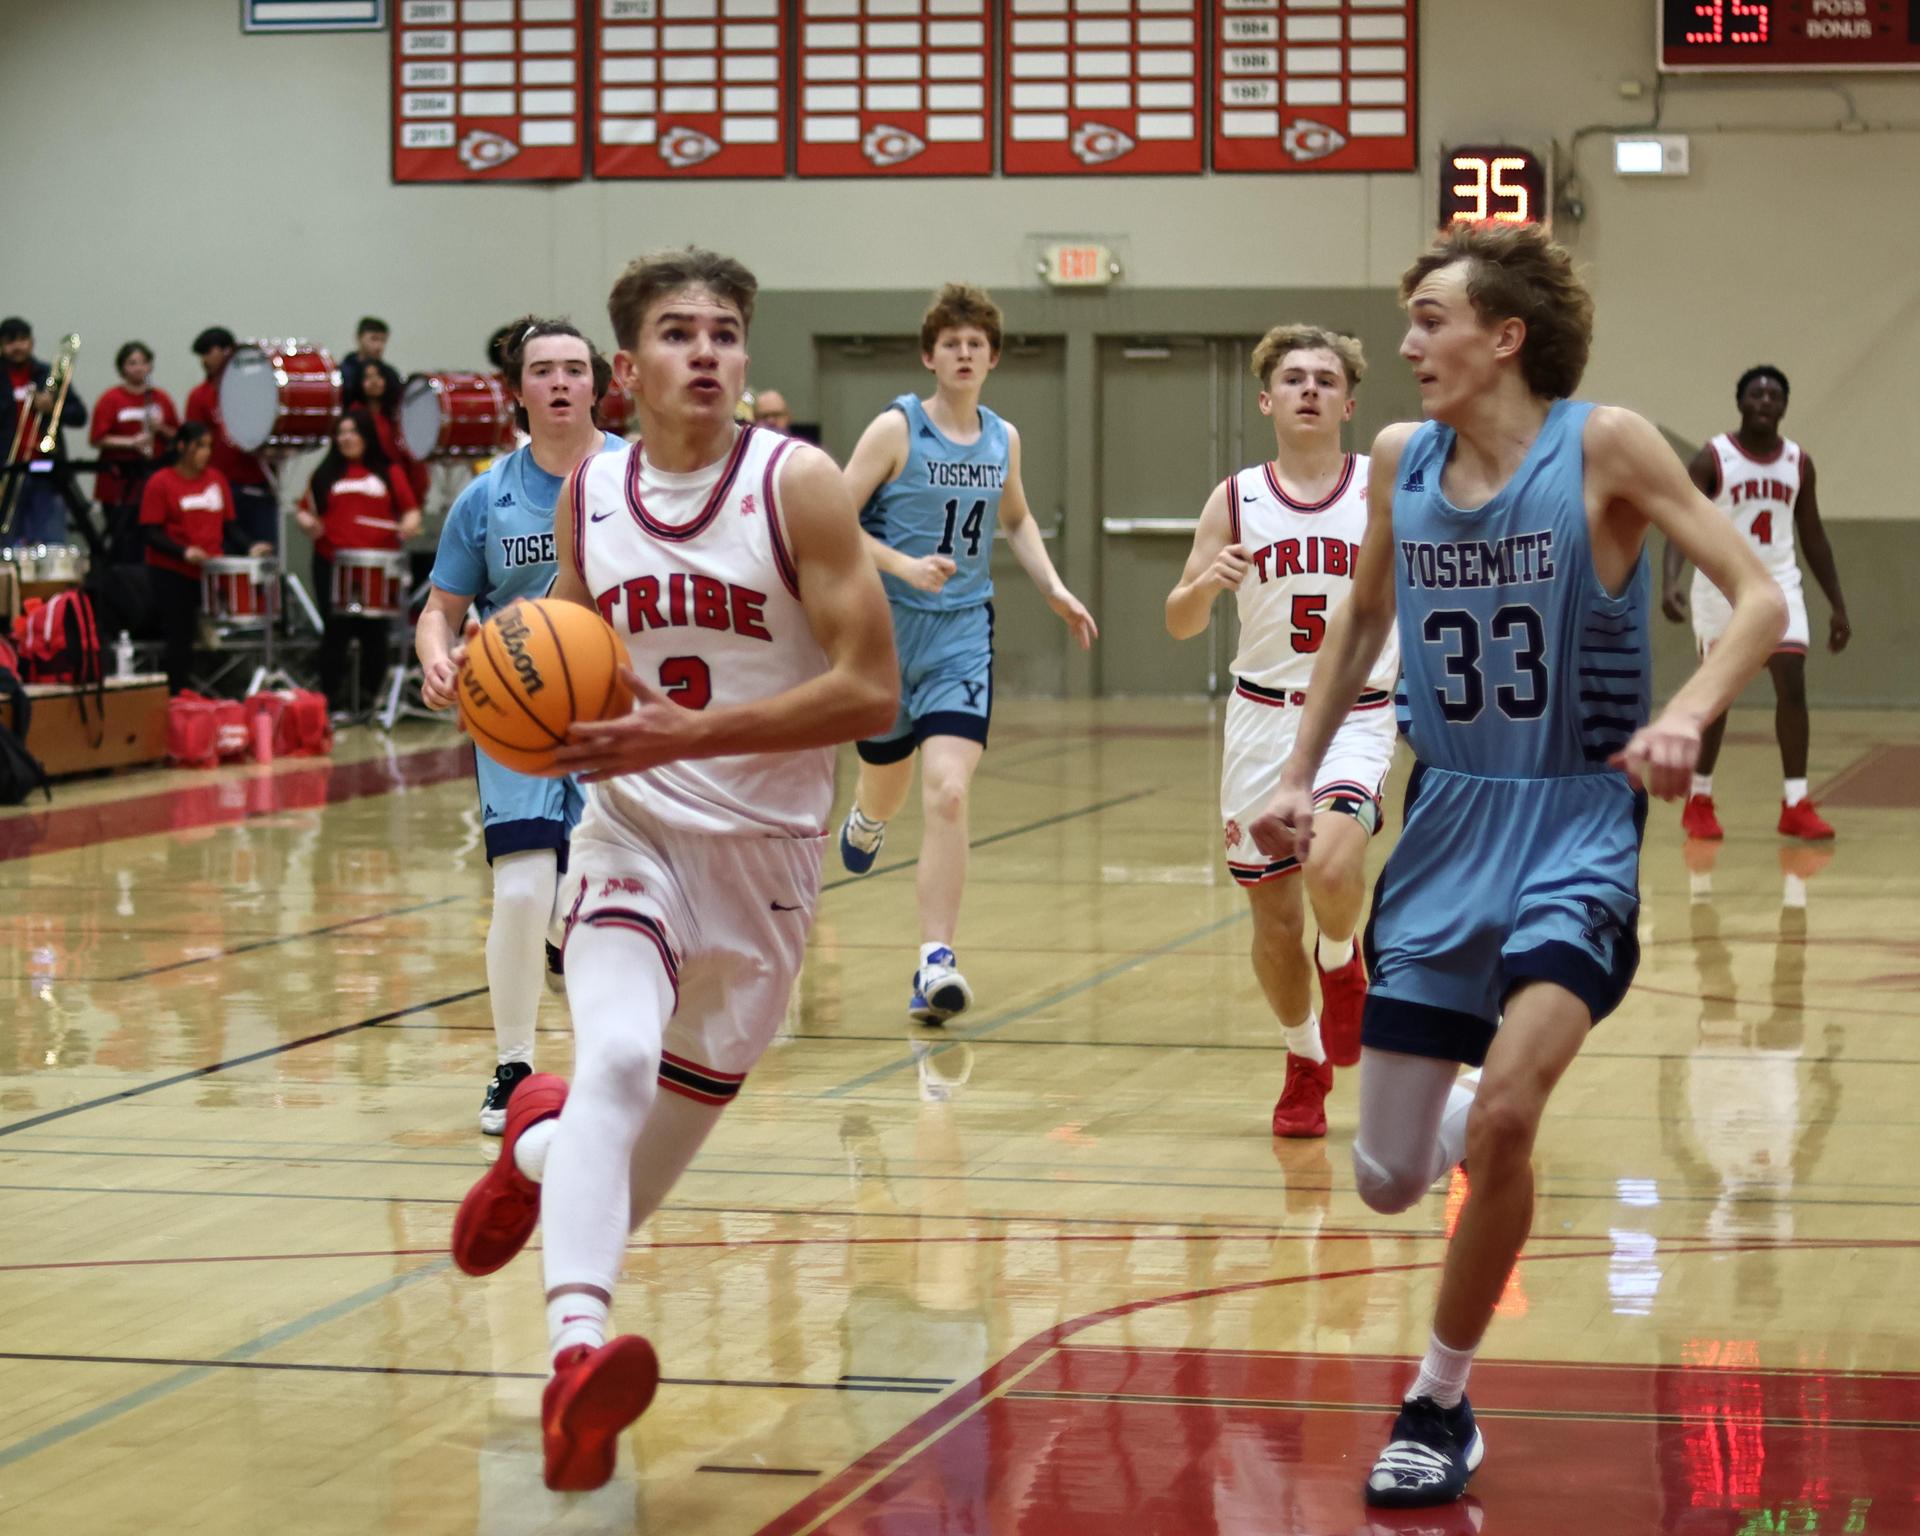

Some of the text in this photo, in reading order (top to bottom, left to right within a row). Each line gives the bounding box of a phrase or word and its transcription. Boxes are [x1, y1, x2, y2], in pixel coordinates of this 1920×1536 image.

[1806, 19, 1872, 38] BONUS
[1453, 157, 1527, 222] 35
[502, 534, 558, 568] YOSE
[937, 498, 986, 556] 14
[1751, 509, 1772, 544] 4
[1401, 529, 1555, 590] YOSEMITE
[596, 573, 773, 642] TRIBE
[1290, 594, 1327, 654] 5
[1423, 603, 1549, 724] 33
[960, 680, 985, 708] Y
